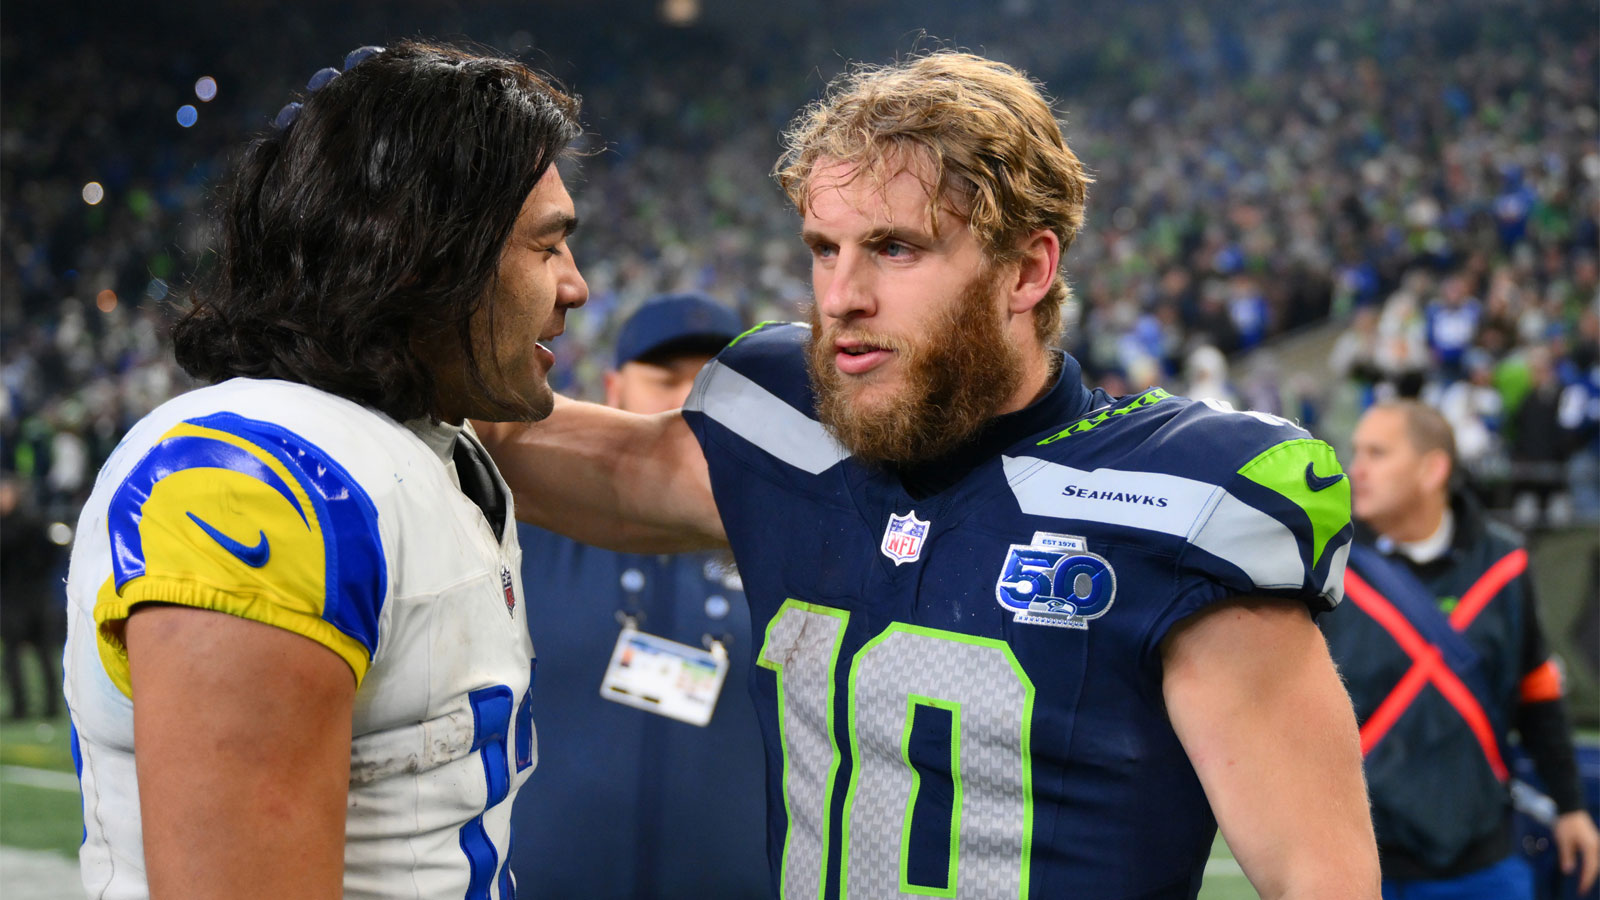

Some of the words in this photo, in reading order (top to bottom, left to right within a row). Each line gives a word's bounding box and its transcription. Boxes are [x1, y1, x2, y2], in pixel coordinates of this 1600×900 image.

[1061, 484, 1169, 508] SEAHAWKS
[887, 531, 918, 556] NFL
[1058, 541, 1078, 549] 1976
[999, 548, 1115, 617] 50
[756, 597, 1036, 900] 10
